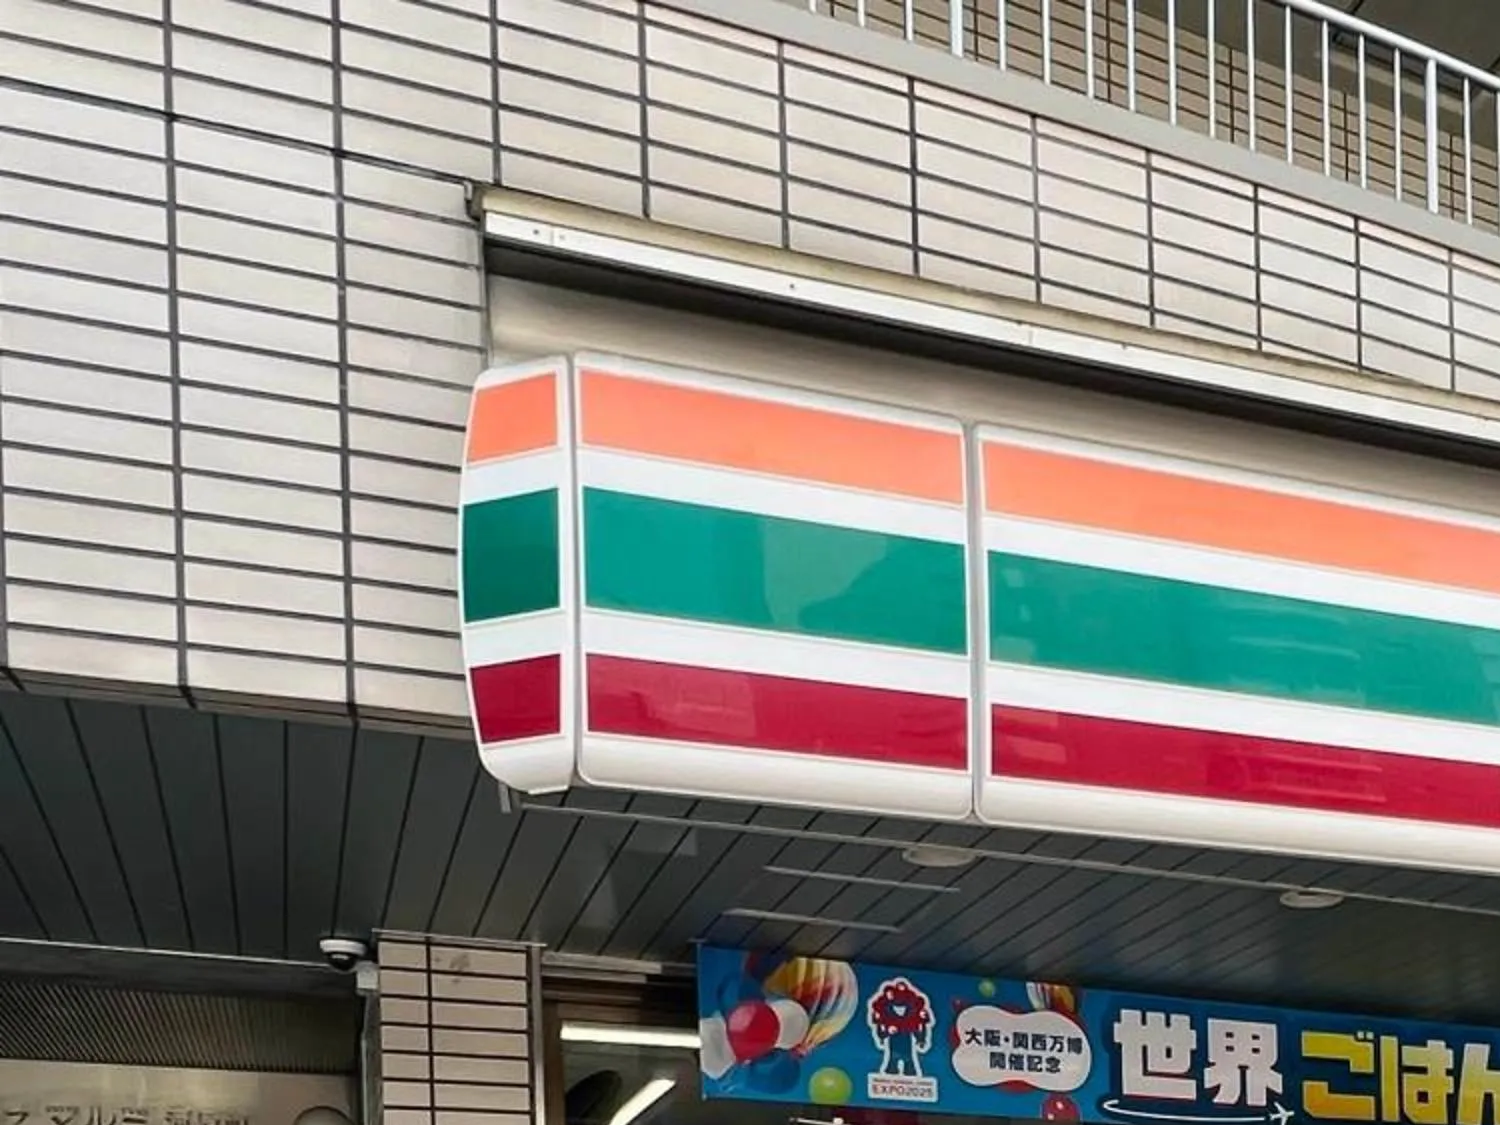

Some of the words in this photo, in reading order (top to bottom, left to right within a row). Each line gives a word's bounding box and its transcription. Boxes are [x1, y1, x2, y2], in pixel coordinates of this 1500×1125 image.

[964, 1027, 1084, 1054] 大阪・関西万博
[989, 1051, 1062, 1074] 開催記念
[1112, 1008, 1284, 1106] 世界
